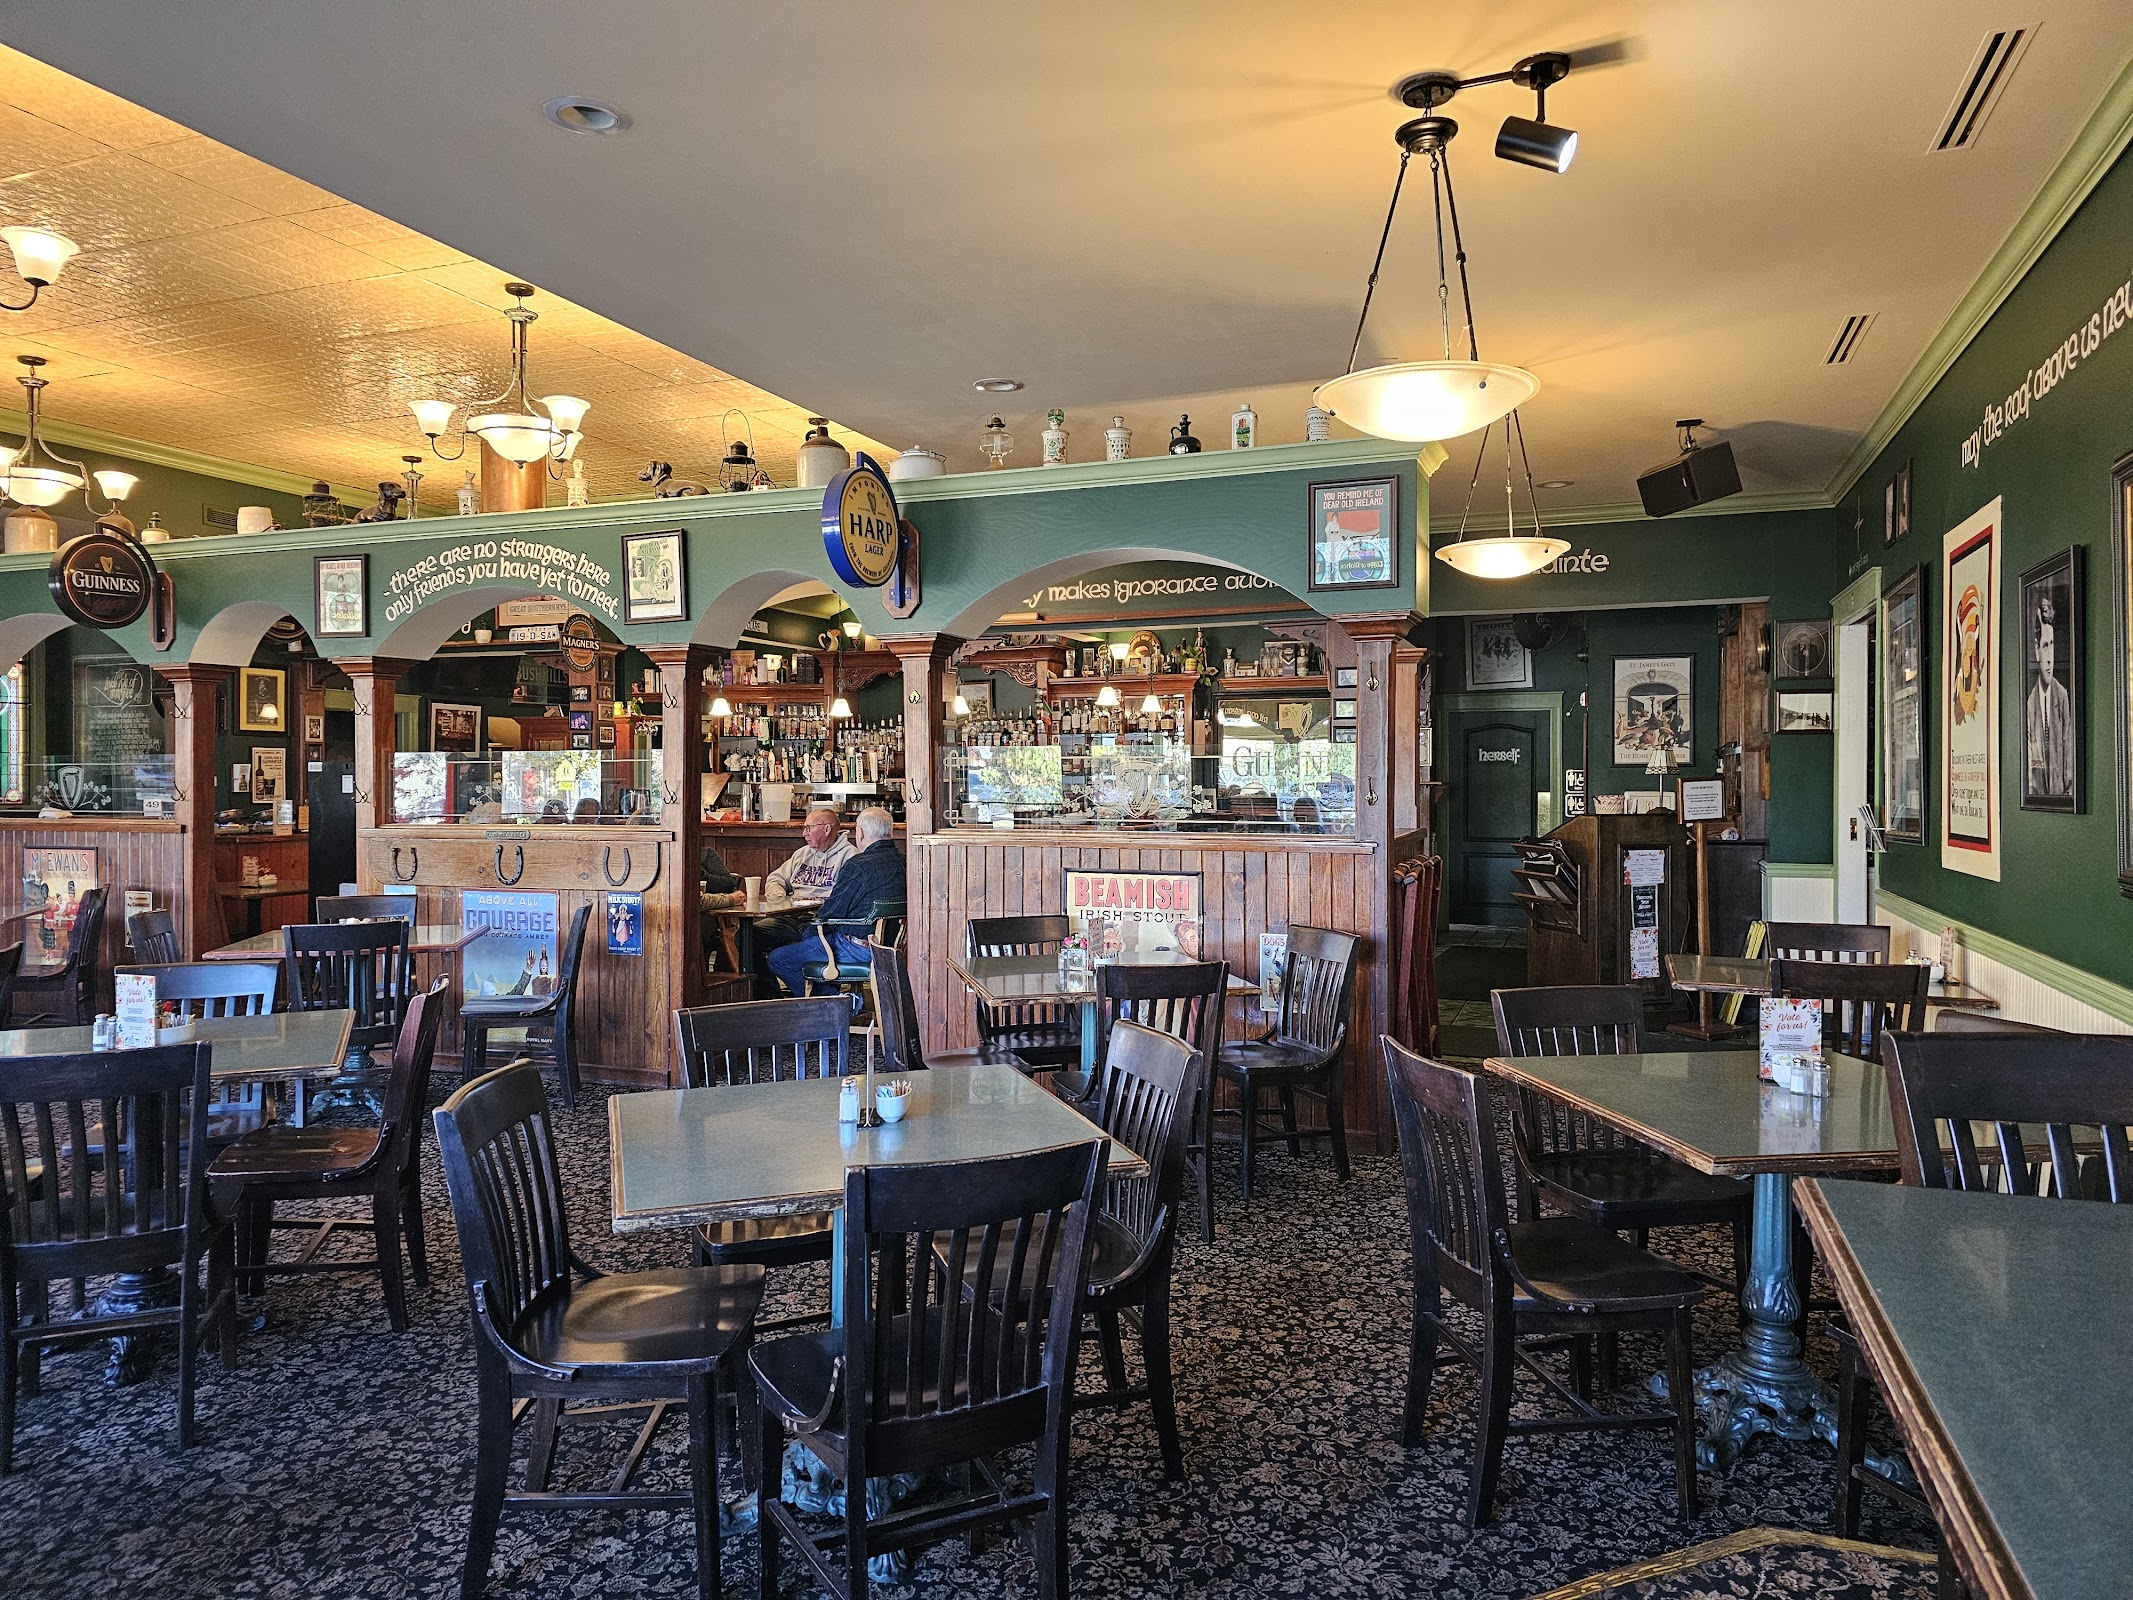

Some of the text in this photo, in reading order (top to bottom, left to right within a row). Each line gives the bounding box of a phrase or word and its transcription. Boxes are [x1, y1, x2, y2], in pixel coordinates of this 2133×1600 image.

[1961, 426, 1982, 469] may
[1983, 403, 2003, 447] the
[2004, 369, 2033, 428] roof
[2033, 332, 2079, 401] above
[2081, 312, 2100, 360] us
[1323, 488, 1384, 501] YOU REMIND ME OF
[1323, 497, 1384, 510] DEAR OLD IRELAND
[849, 512, 893, 547] HARP
[864, 543, 884, 557] LAGER
[439, 544, 472, 567] are
[473, 540, 497, 560] no
[500, 537, 577, 572] strangers
[575, 550, 611, 588] here
[71, 570, 141, 593] GUINNESS
[1048, 580, 1111, 601] makes
[1113, 574, 1219, 604] ignorance
[385, 590, 414, 622] only
[413, 565, 466, 606] friends
[465, 562, 498, 585] you
[499, 557, 541, 581] have
[536, 566, 567, 592] yet
[566, 571, 583, 598] to
[509, 605, 527, 613] GREAT
[527, 604, 555, 613] SOUTHERN
[562, 636, 600, 651] MAGNERS
[1478, 747, 1521, 765] herself
[1620, 752, 1648, 760] THE HOME
[145, 800, 160, 809] 49
[478, 895, 516, 906] ABOVE
[1074, 876, 1190, 911] BEAMISH
[465, 909, 554, 932] COURAGE
[1079, 909, 1188, 924] IRISH STOUT
[1778, 1013, 1801, 1022] Vote
[1776, 1020, 1808, 1032] for us!
